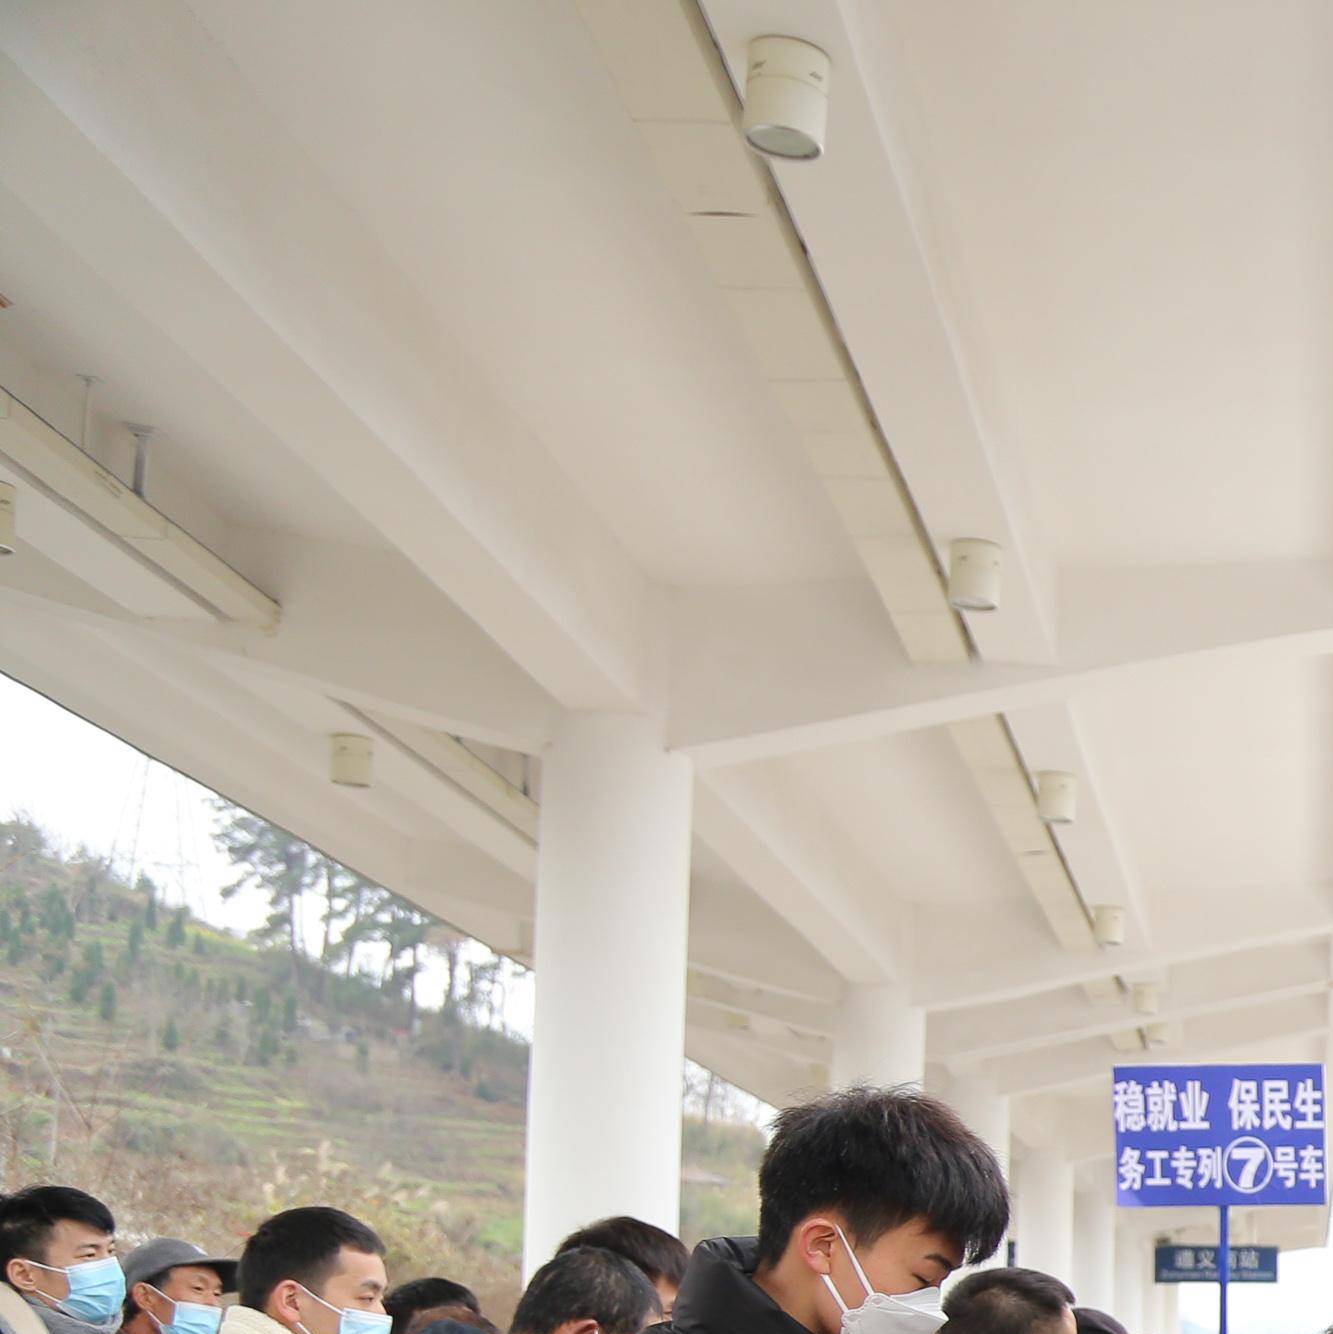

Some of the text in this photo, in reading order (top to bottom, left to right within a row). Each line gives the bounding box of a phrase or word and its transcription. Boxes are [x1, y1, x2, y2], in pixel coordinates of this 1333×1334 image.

[1113, 1078, 1325, 1132] 稳就业 保民生
